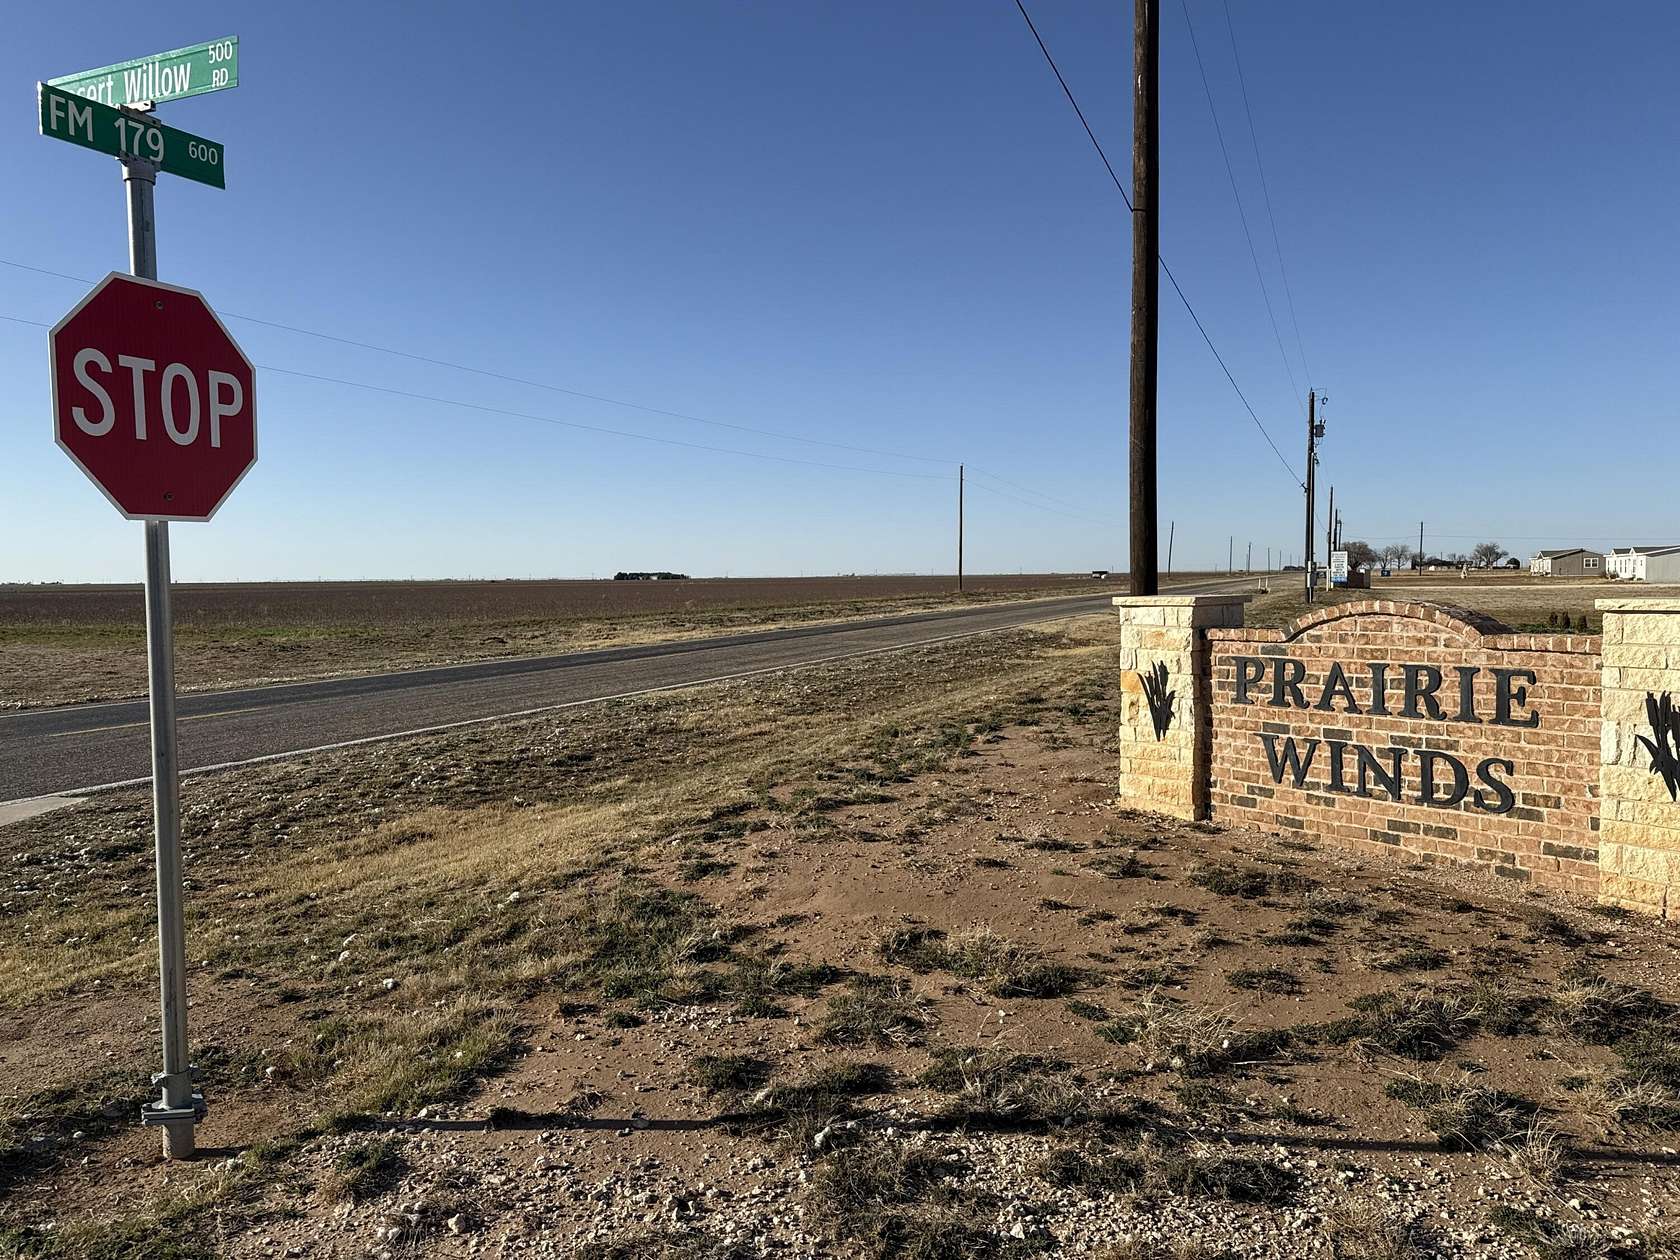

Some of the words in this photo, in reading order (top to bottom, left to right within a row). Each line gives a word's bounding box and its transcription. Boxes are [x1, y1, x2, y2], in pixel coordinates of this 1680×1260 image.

[123, 61, 191, 101] Willow
[208, 40, 233, 64] 500
[211, 67, 229, 88] RD
[50, 94, 93, 142] FM
[113, 117, 165, 162] 179
[188, 141, 218, 165] 600
[72, 348, 243, 448] STOP
[1230, 656, 1540, 729] PRAIRIE
[1253, 733, 1515, 814] WINDS
